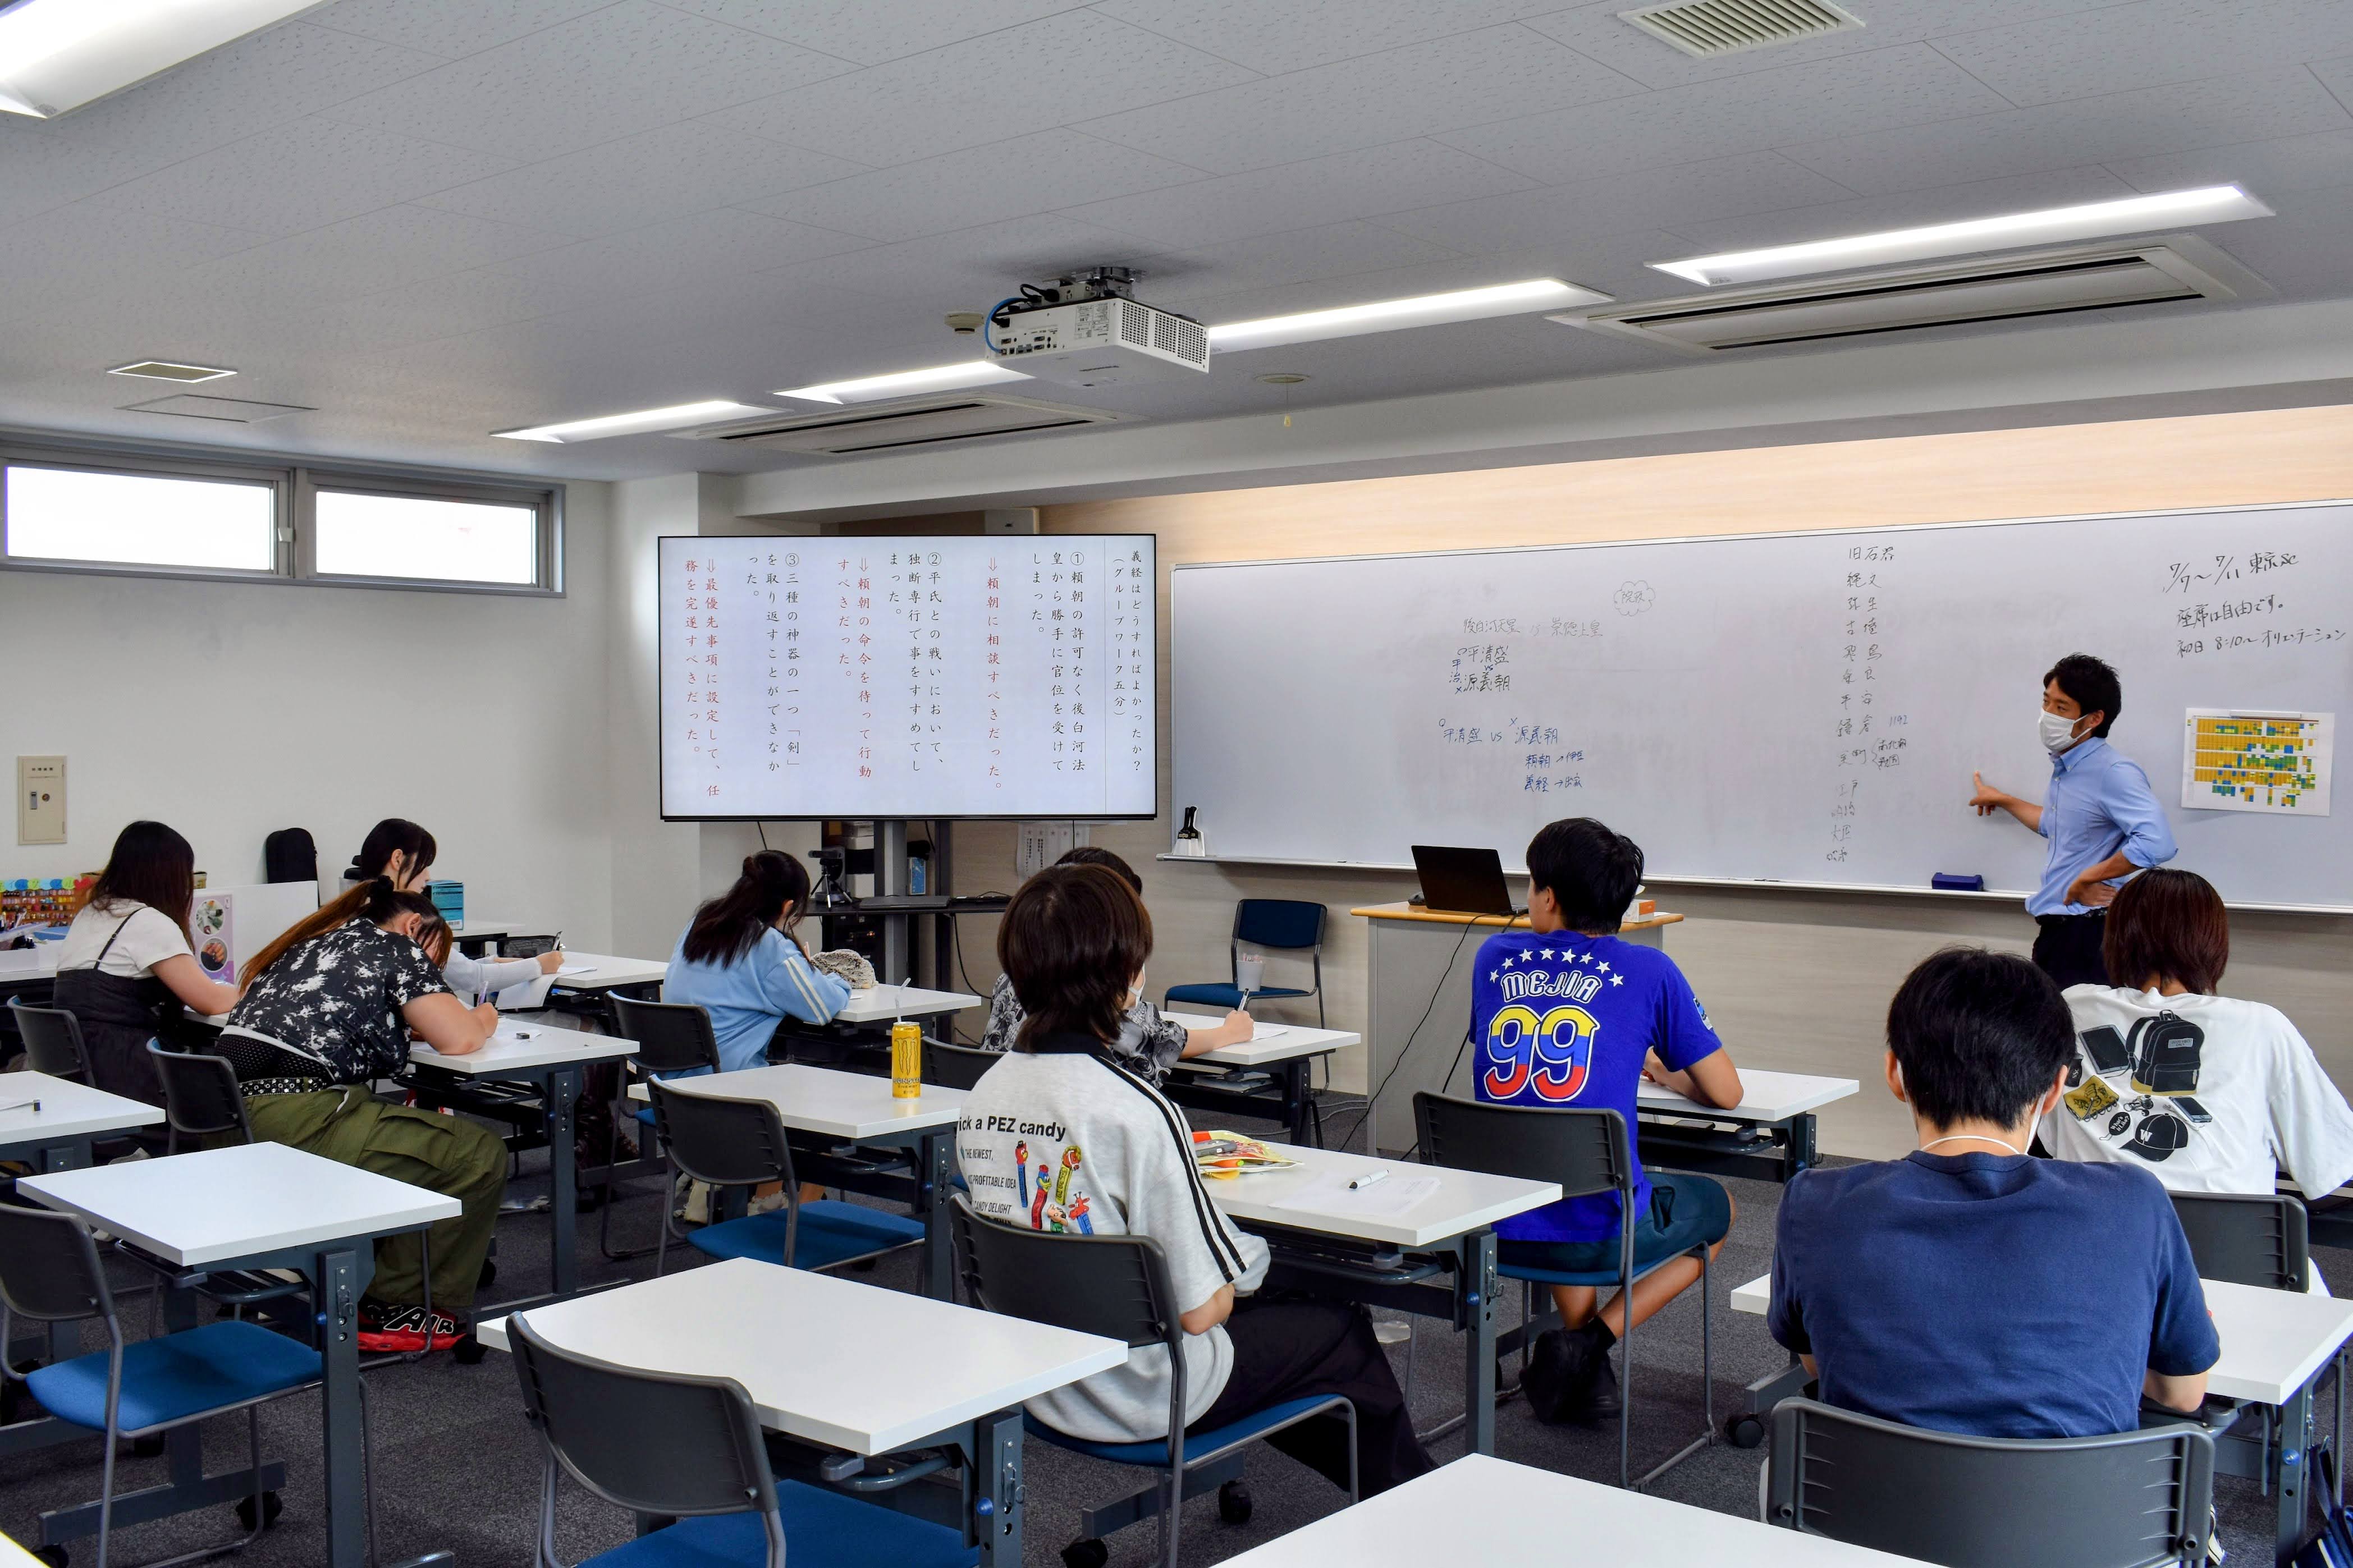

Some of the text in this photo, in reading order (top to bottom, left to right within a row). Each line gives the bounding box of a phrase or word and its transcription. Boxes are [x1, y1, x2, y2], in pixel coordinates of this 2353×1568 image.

[747, 557, 759, 596] った。
[890, 553, 901, 614] まった。
[1032, 553, 1044, 632] しまった。
[839, 560, 851, 676] すべきだった。
[1500, 970, 1603, 1003] MEJIA
[1484, 1004, 1600, 1102] 99
[959, 1116, 1066, 1141] ick a PEZ candy
[2140, 1129, 2153, 1141] W
[1005, 1179, 1016, 1189] IDEA
[988, 1202, 1012, 1215] DELIGHT
